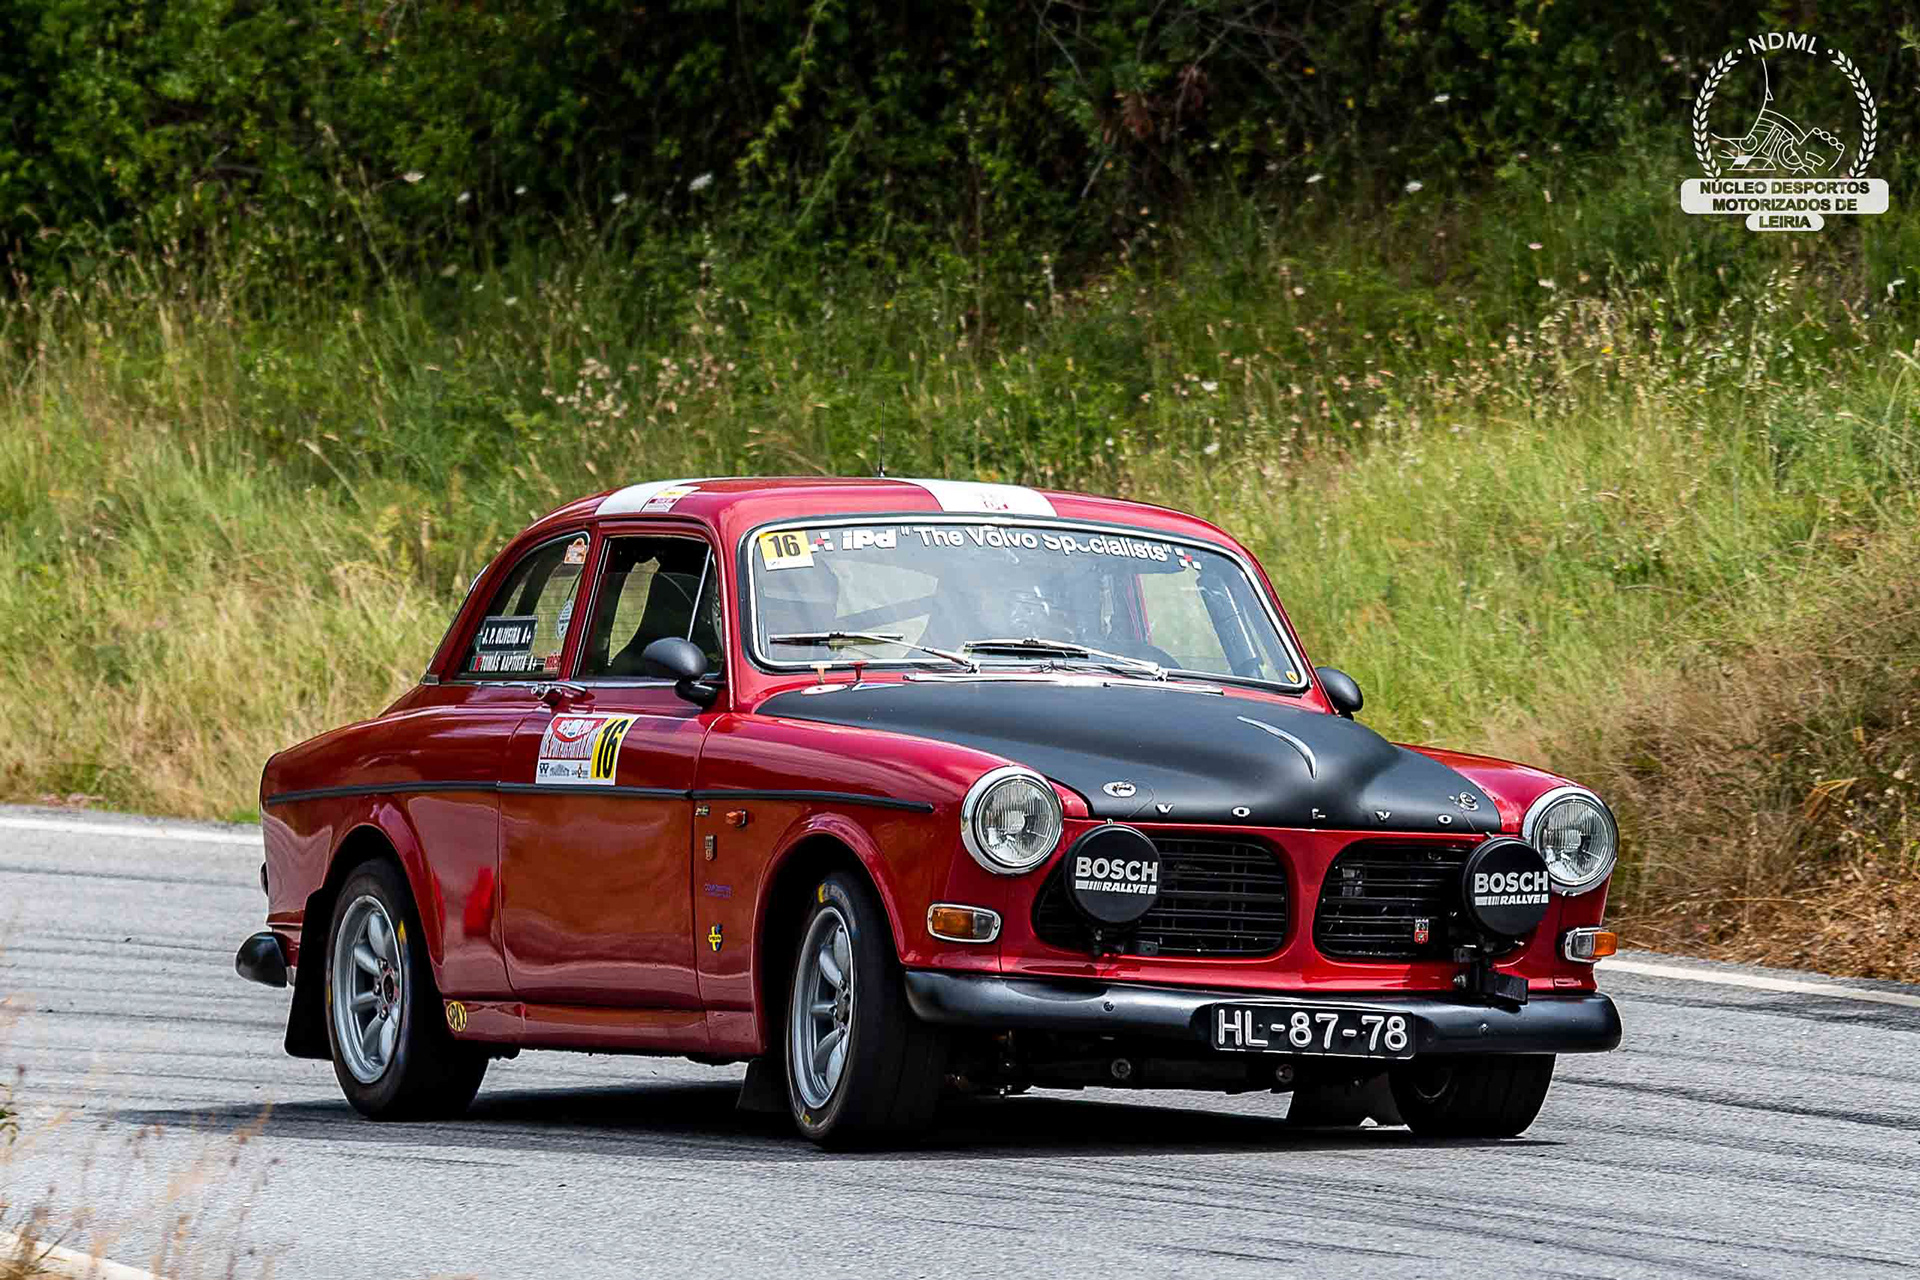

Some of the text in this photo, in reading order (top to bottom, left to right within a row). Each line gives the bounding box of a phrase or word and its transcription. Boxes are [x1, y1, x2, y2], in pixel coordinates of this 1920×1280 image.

[768, 534, 801, 557] 16
[965, 525, 1038, 549] Volvo
[596, 719, 629, 778] 16
[1075, 856, 1158, 882] BOSCH
[1102, 881, 1148, 894] RALLYE
[1474, 871, 1549, 893] BOSCH
[1500, 894, 1541, 905] RALLYE
[1218, 1009, 1408, 1051] HL-87-78
